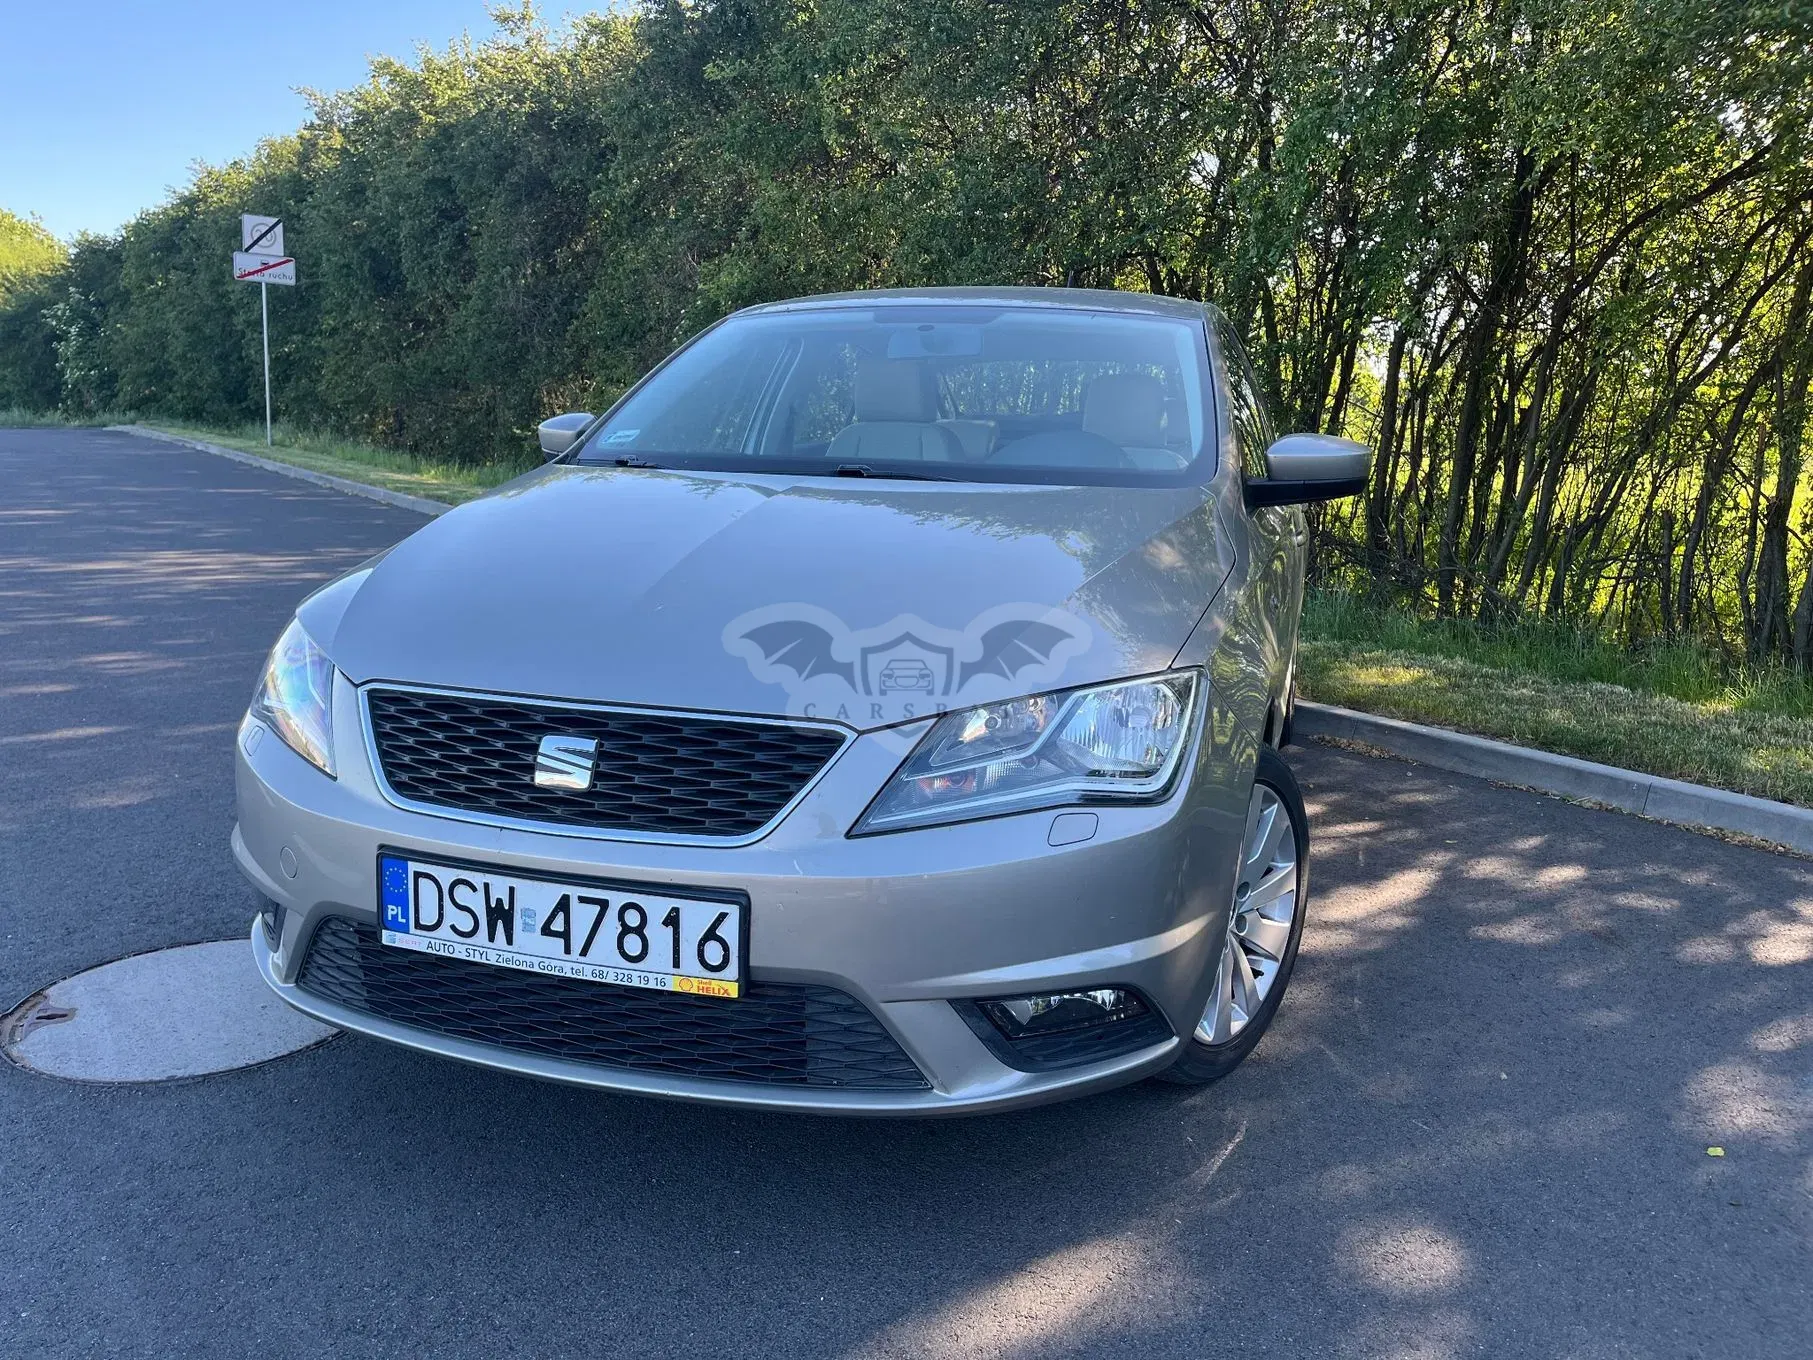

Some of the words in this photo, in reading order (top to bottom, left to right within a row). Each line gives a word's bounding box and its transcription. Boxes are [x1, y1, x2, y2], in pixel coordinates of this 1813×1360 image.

[387, 904, 406, 923] PL
[413, 870, 516, 946] DSW
[540, 893, 731, 973] 47816
[426, 940, 456, 955] AUTO
[465, 947, 491, 962] STYL
[496, 953, 535, 969] Zielona
[571, 964, 588, 978] tel.
[591, 969, 609, 981] 68/
[613, 971, 633, 984] 328
[637, 975, 650, 985] 19
[654, 976, 667, 988] 16
[696, 985, 731, 996] HELIX
